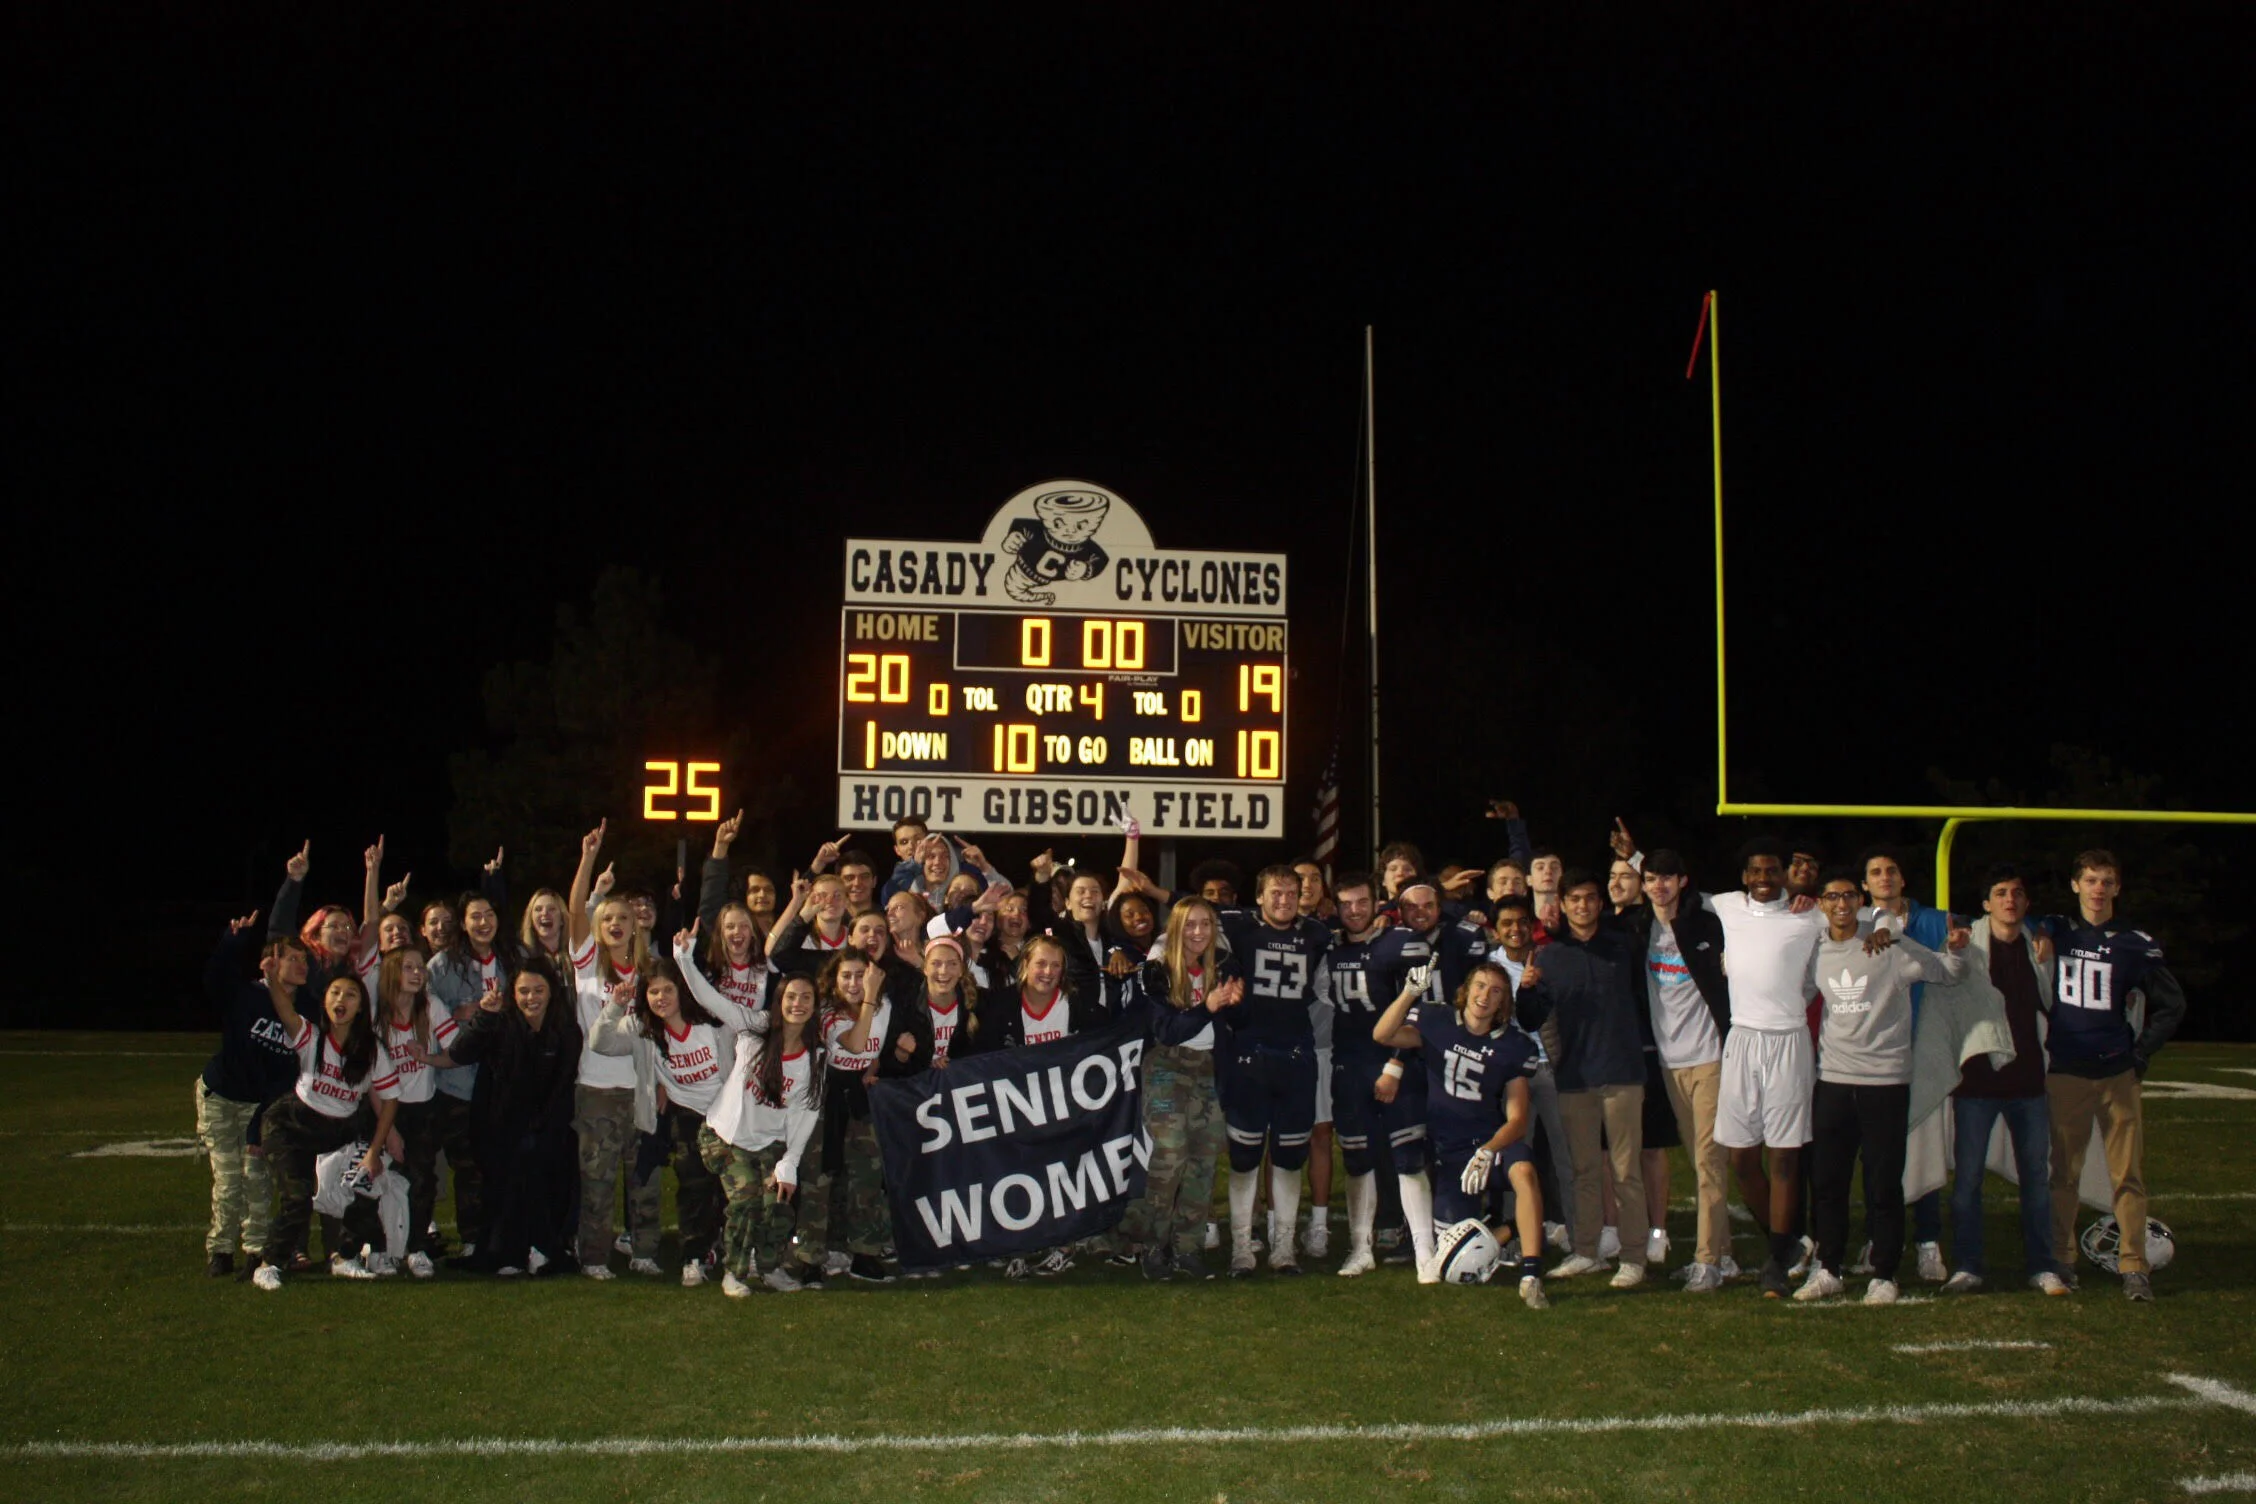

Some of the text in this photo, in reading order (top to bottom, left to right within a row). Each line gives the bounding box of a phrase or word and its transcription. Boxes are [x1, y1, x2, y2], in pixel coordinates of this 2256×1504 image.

[851, 548, 1281, 605] CASADY CYCLONES
[856, 612, 939, 641] HOME
[1022, 618, 1144, 669] 0 00
[1183, 622, 1284, 651] VISITOR
[848, 653, 909, 702] 20
[929, 683, 998, 715] 0 TOL
[1026, 682, 1103, 720] QTR 4
[1239, 664, 1281, 713] 19
[1133, 690, 1201, 722] TOL 0
[866, 720, 947, 769] 1 DOWN
[994, 724, 1107, 772] 10 TO GO
[1129, 730, 1279, 778] BALL ON 10
[644, 761, 720, 821] 25
[853, 784, 1269, 829] HOOT GIBSON FIELD
[1253, 949, 1307, 999] 53
[1332, 970, 1376, 1013] 14
[2059, 955, 2112, 1010] 80
[1831, 1001, 1871, 1014] adidas
[669, 1046, 713, 1069] SENIOR
[672, 1063, 719, 1085] WOMEN
[1444, 1049, 1485, 1101] 15
[311, 1079, 359, 1103] WOMEN
[916, 1038, 1144, 1154] SENIOR
